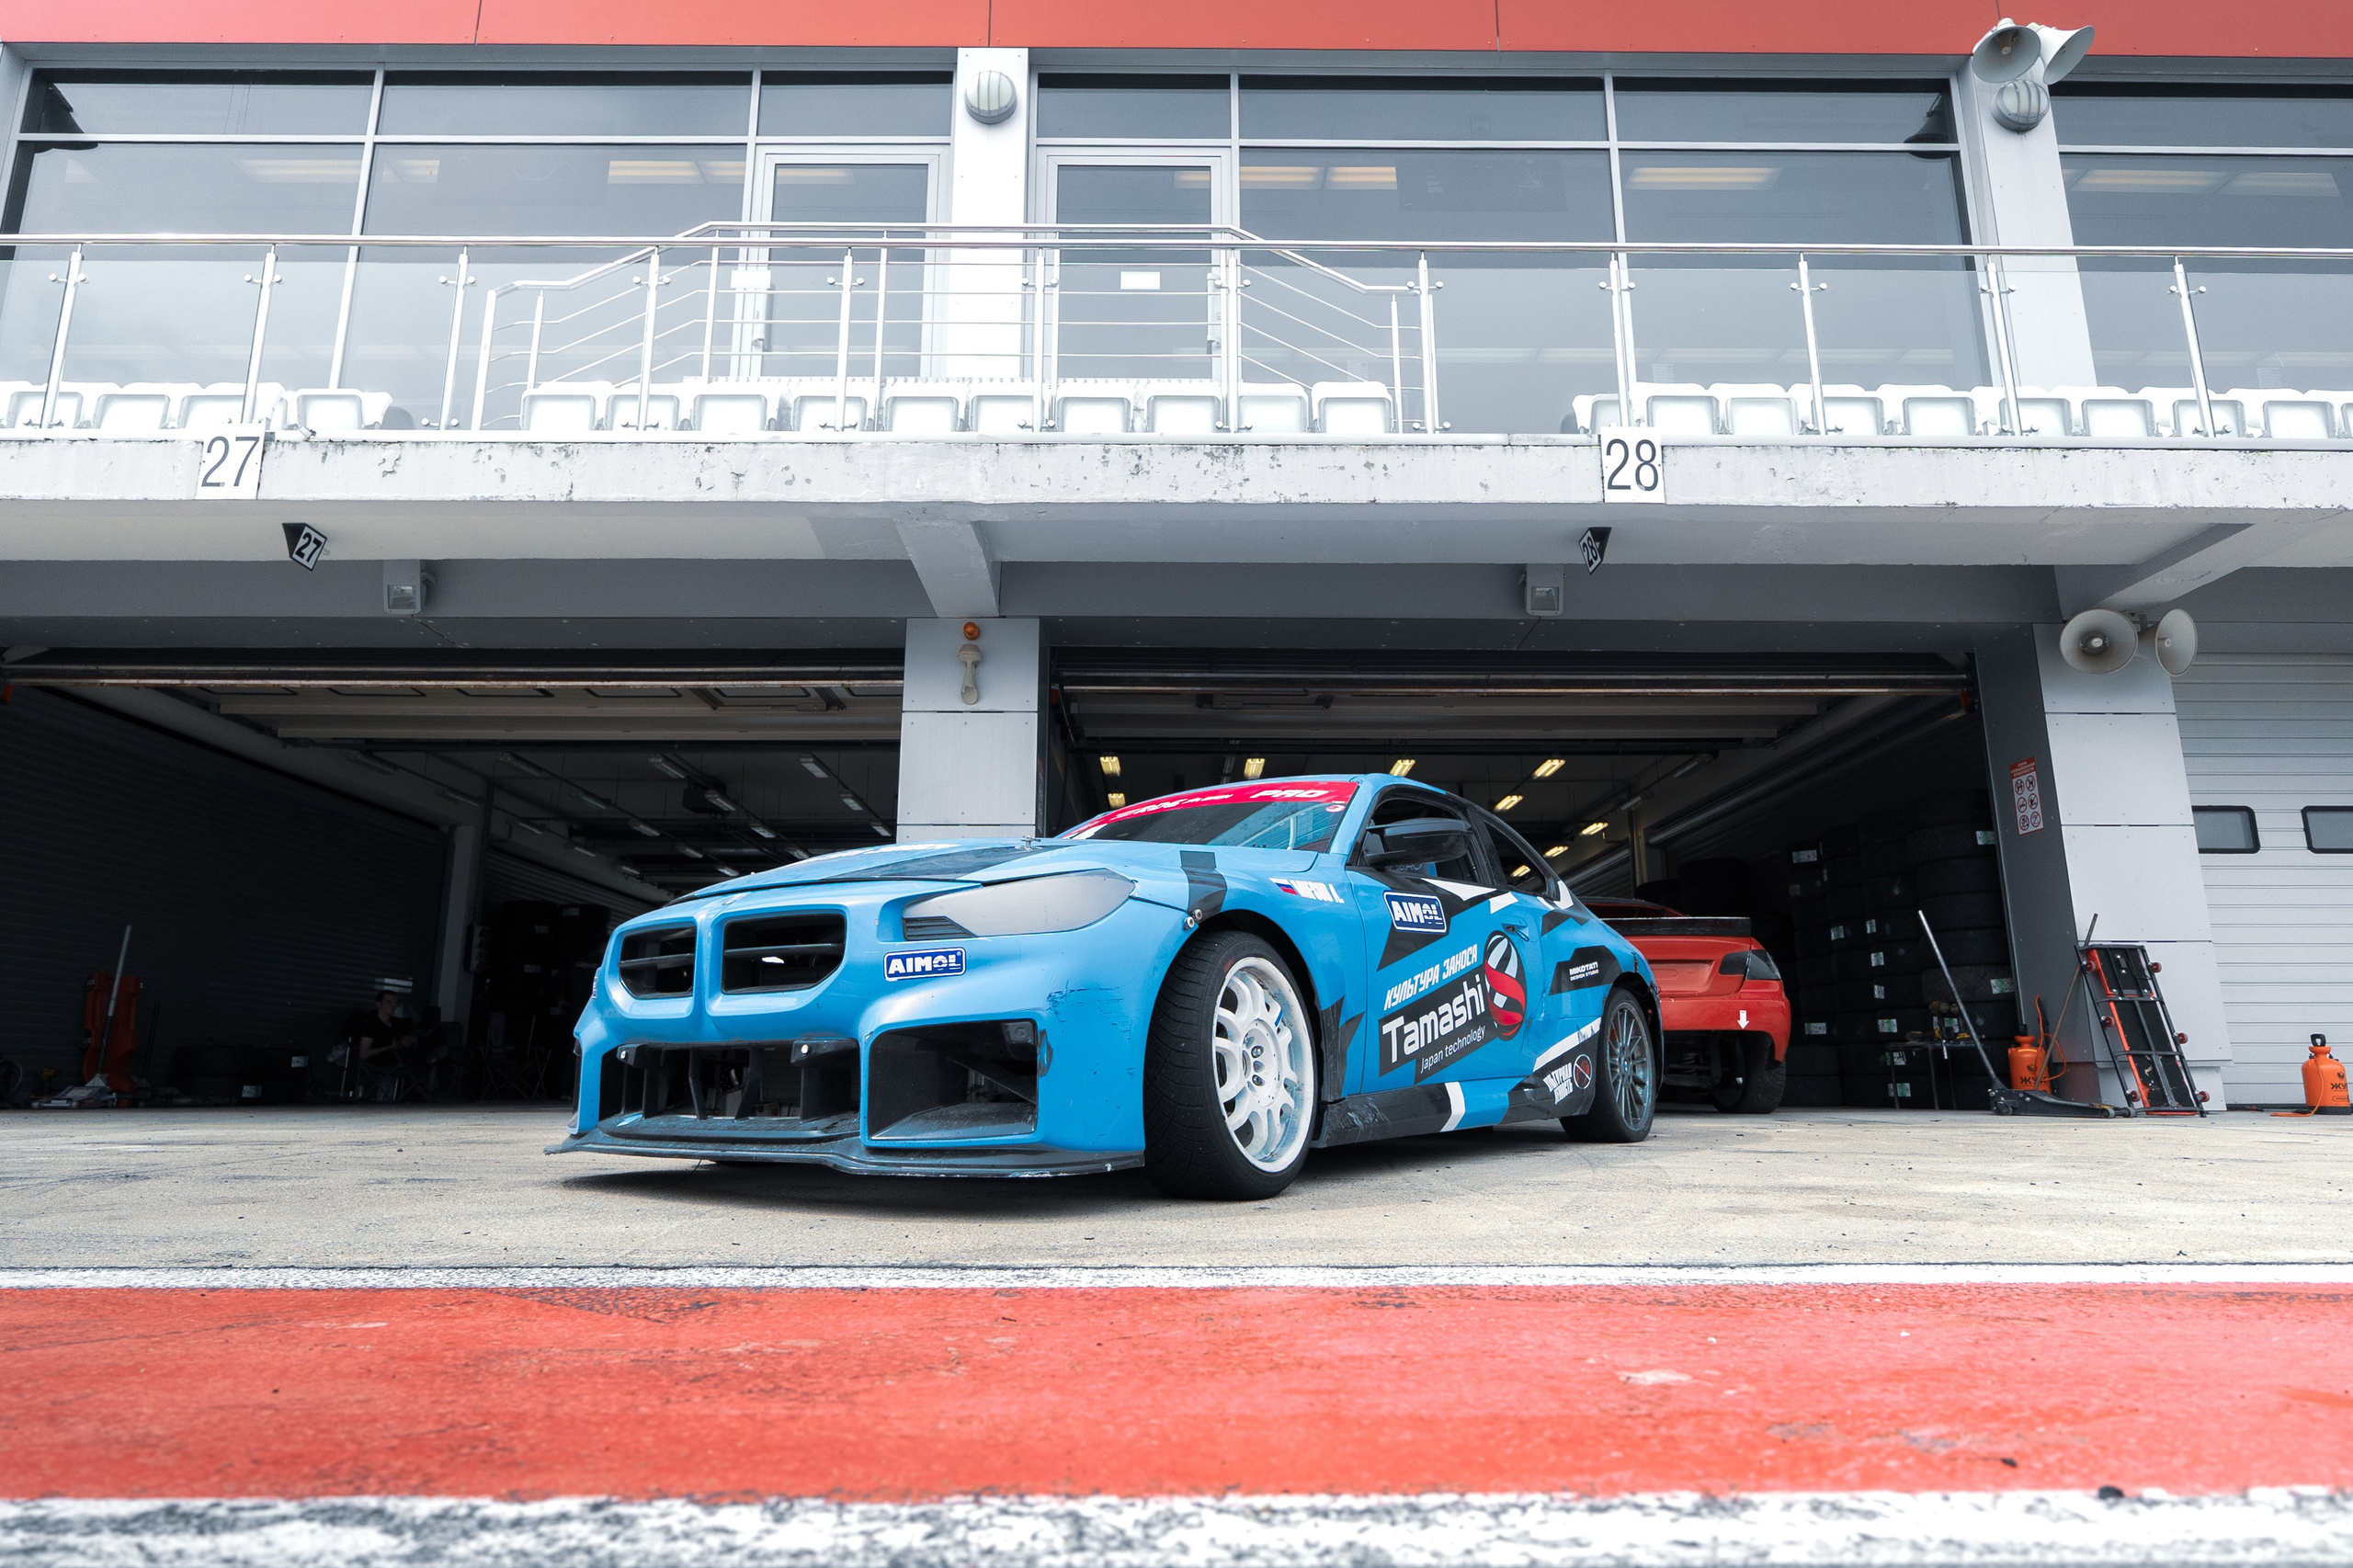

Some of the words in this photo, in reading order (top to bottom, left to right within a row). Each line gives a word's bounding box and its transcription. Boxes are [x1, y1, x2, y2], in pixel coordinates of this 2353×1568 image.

[201, 436, 260, 487] 27
[1606, 438, 1659, 492] 28
[294, 531, 324, 563] 27
[1582, 535, 1598, 567] 28
[1249, 789, 1329, 799] PRO
[1391, 901, 1443, 925] AIMOL
[888, 954, 961, 974] AIMOL
[1383, 963, 1440, 1011] КУЛЬТУРА
[1442, 943, 1478, 980] ЗАНОСА
[1569, 961, 1598, 975] MIKOTATI
[1381, 973, 1485, 1063] Tamashi
[1420, 1050, 1444, 1074] Japan
[1445, 1025, 1486, 1058] technology
